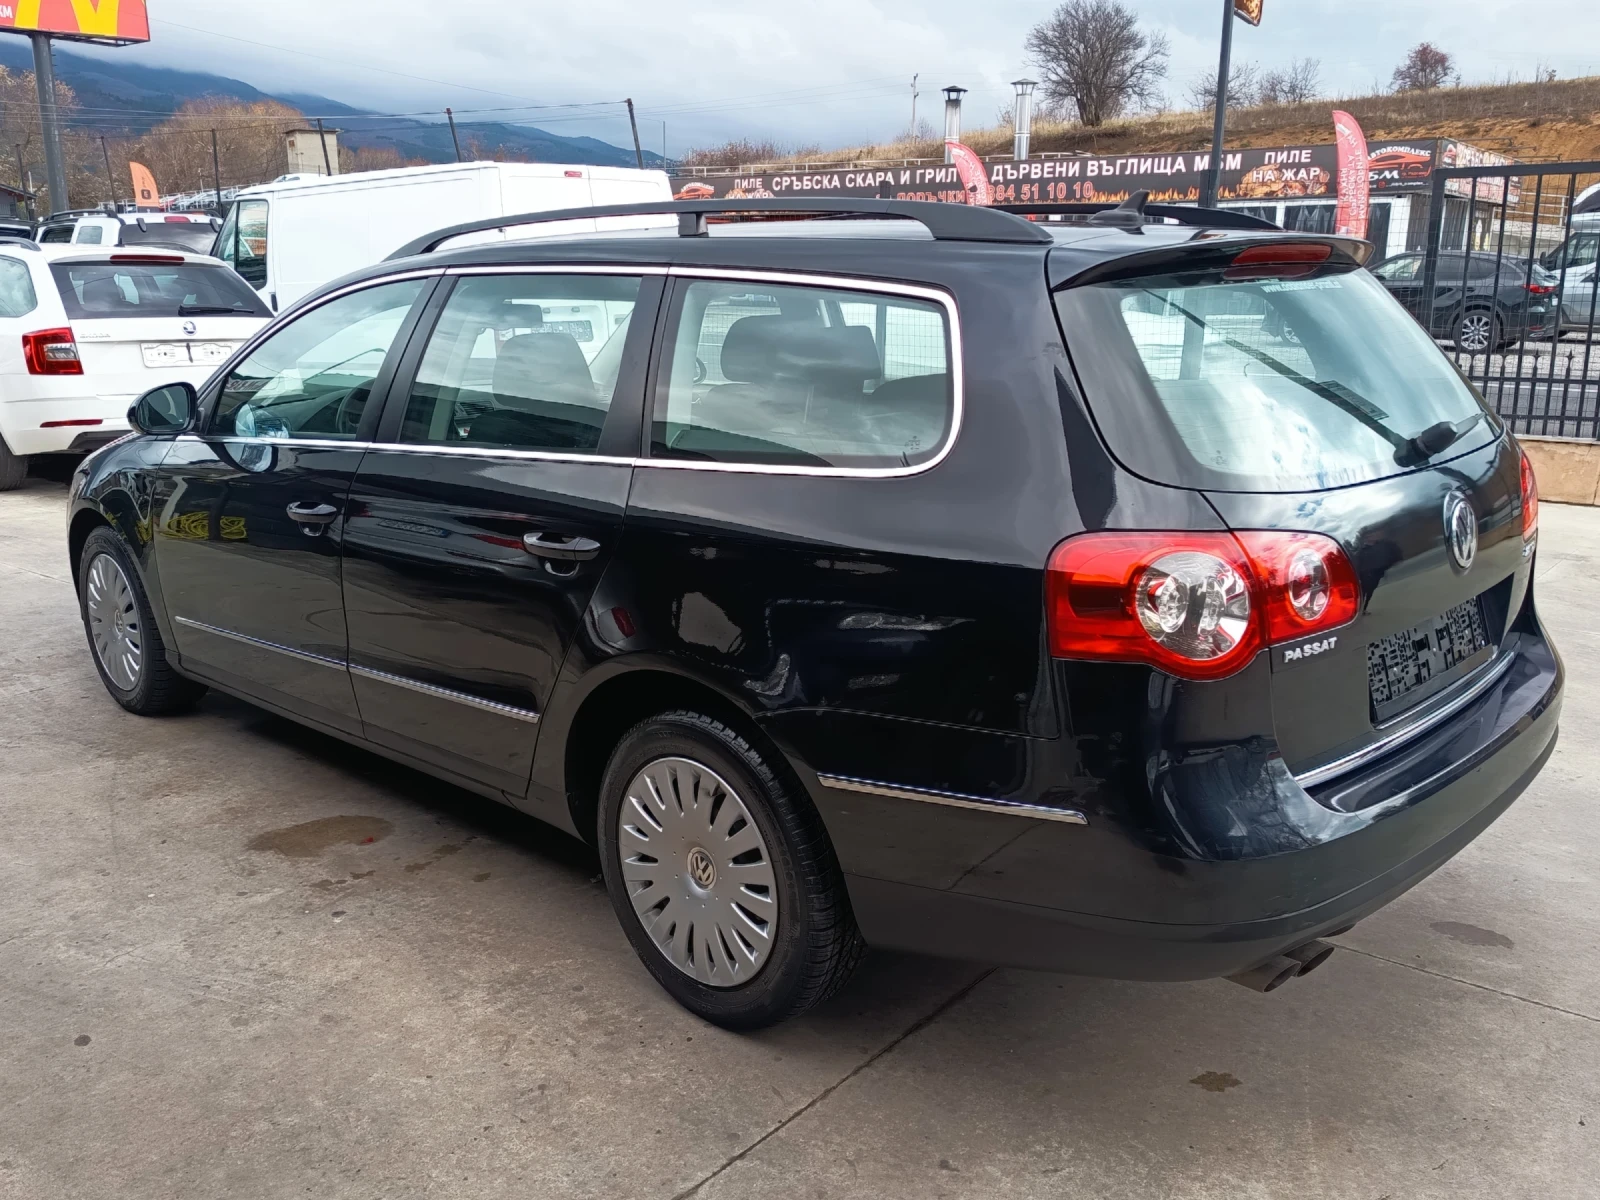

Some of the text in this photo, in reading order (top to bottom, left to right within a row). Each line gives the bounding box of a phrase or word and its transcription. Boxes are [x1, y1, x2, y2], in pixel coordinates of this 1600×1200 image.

[1264, 149, 1312, 164] ПИЛЕ
[772, 174, 840, 191] СРЪБСКА
[845, 171, 895, 188] СКАРА
[900, 170, 910, 185] И
[916, 168, 957, 184] ГРИЛ
[991, 161, 1080, 183] ДЪРВЕНИ
[1087, 156, 1187, 177] ВЪГЛИЩА
[1252, 167, 1320, 182] НА ЖАР
[734, 178, 763, 189] ПИЛЕ
[1020, 183, 1039, 200] 51
[1047, 182, 1067, 199] 10
[1073, 181, 1094, 199] 10
[1284, 636, 1338, 663] PASSAT
